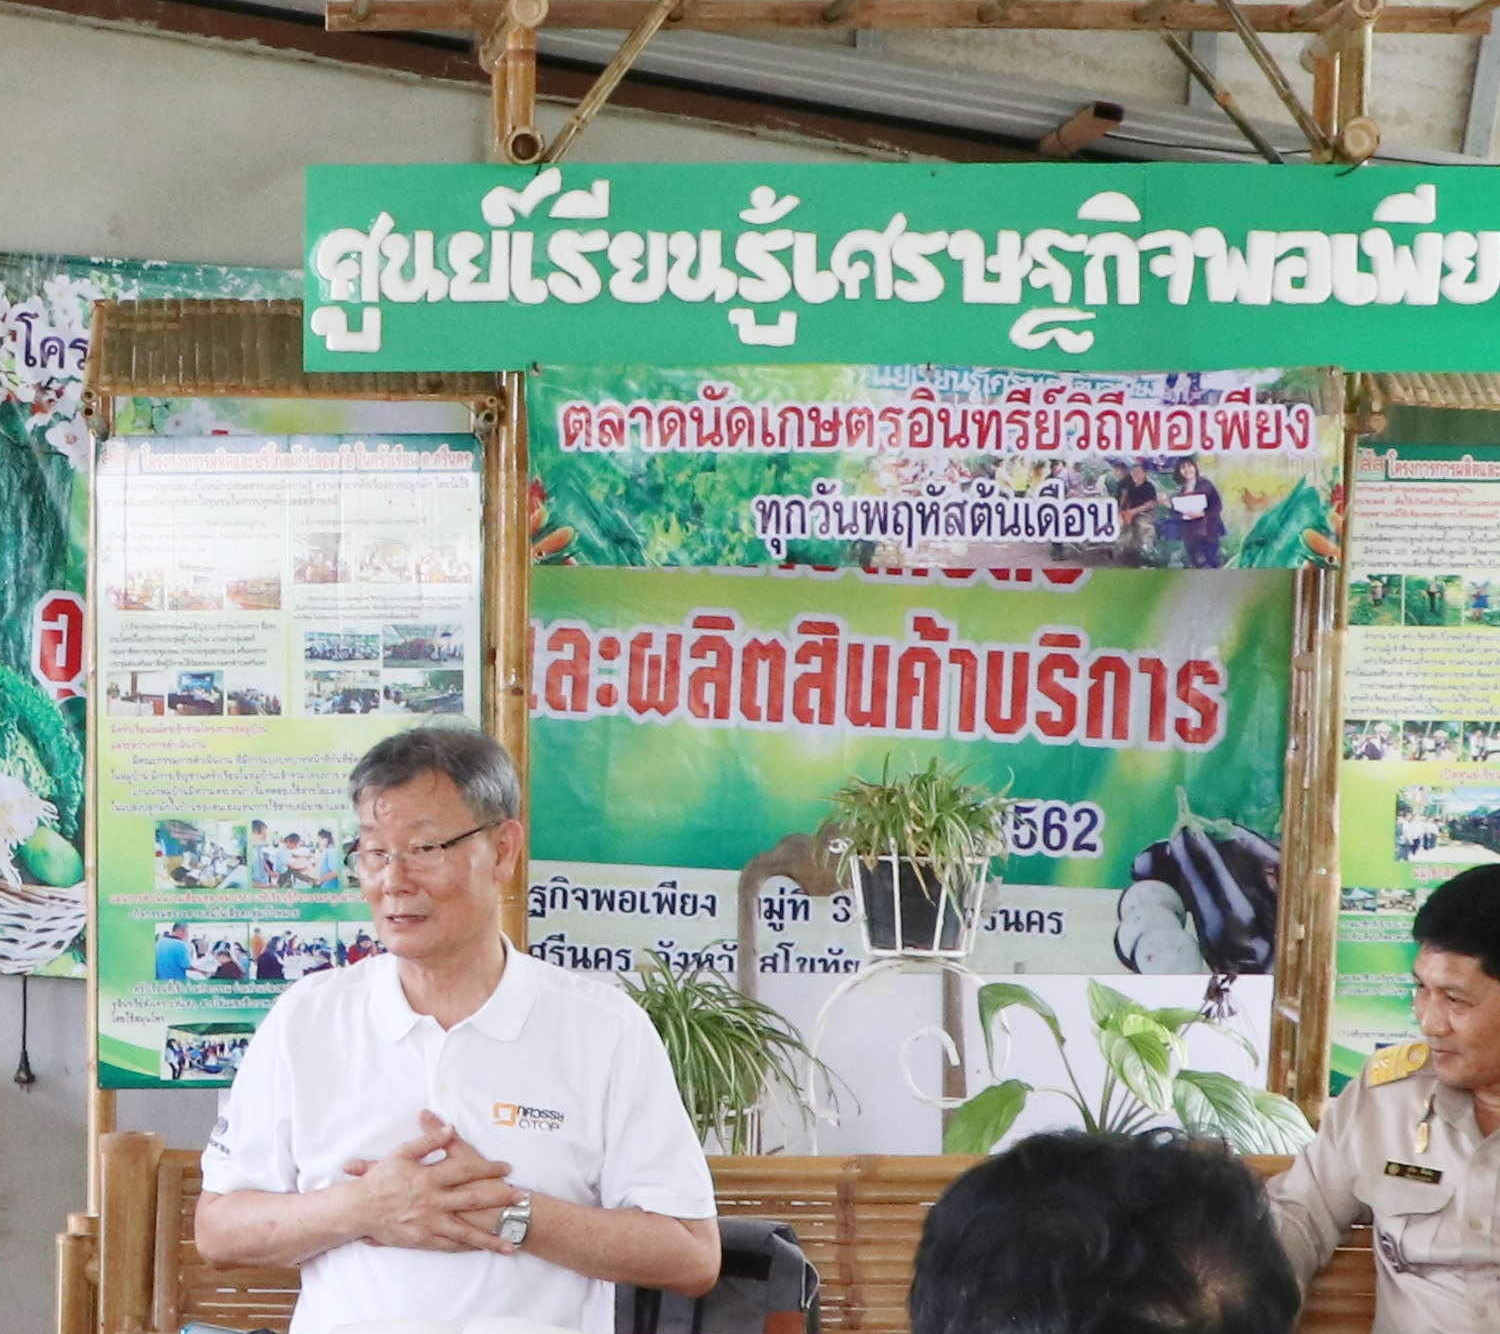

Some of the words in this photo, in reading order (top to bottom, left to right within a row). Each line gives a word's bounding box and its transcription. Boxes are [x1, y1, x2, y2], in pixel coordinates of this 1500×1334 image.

[14, 310, 89, 371] โคร
[562, 381, 1312, 456] ตลาดนัดเกษตรอินทรีย์วิถีพอเพียง
[755, 479, 1117, 553] ทุกวันพฤหัสต้นเดือน
[1000, 804, 1098, 853] 562
[518, 1118, 560, 1133] OTOP
